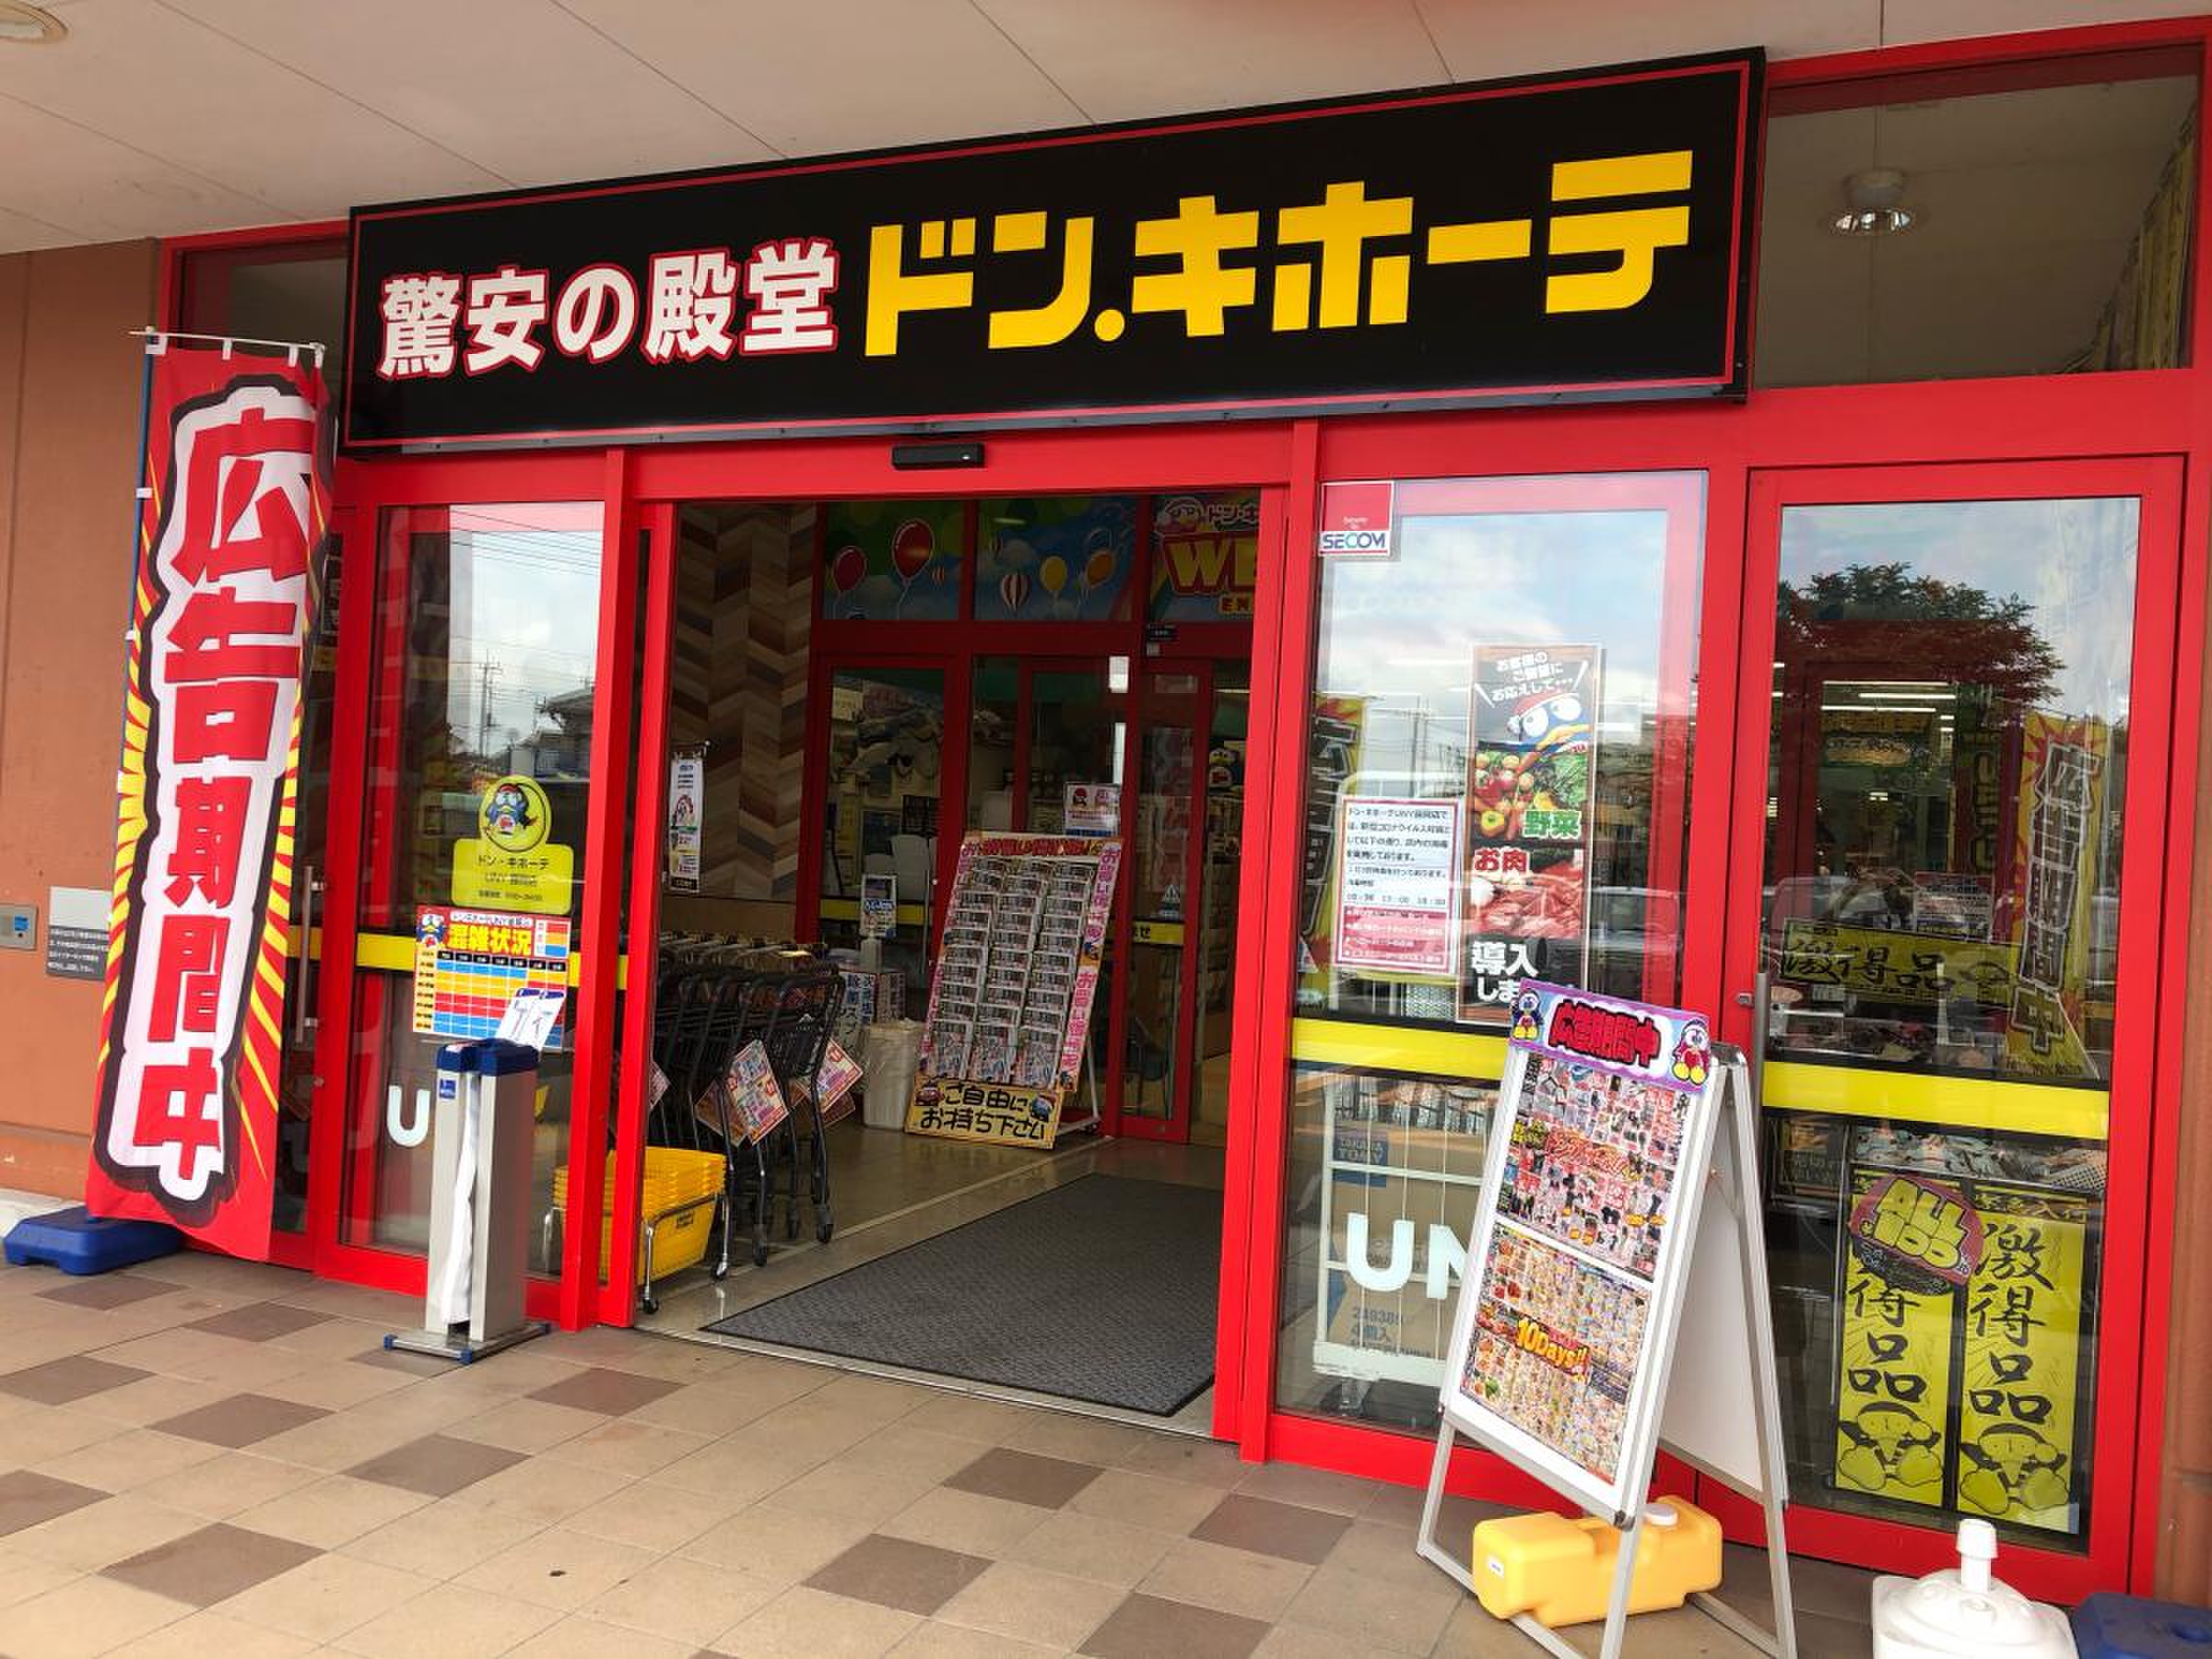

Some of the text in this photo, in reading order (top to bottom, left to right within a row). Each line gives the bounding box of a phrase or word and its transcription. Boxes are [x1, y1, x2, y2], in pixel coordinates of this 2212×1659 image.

[380, 239, 838, 379] 驚安の殿堂
[1323, 532, 1386, 549] SECOM
[132, 407, 317, 1182] 広告期間中
[1524, 809, 1583, 840] 野菜
[1474, 847, 1529, 874] お肉
[447, 922, 532, 957] 混雑状況
[1472, 941, 1538, 977] 導入
[1548, 999, 1661, 1068] 広告期間中
[945, 1081, 1029, 1112] ご自由に
[921, 1106, 1045, 1140] お持ち下さい
[1847, 1265, 1929, 1403] 得品
[1970, 1221, 2055, 1426] 激得品
